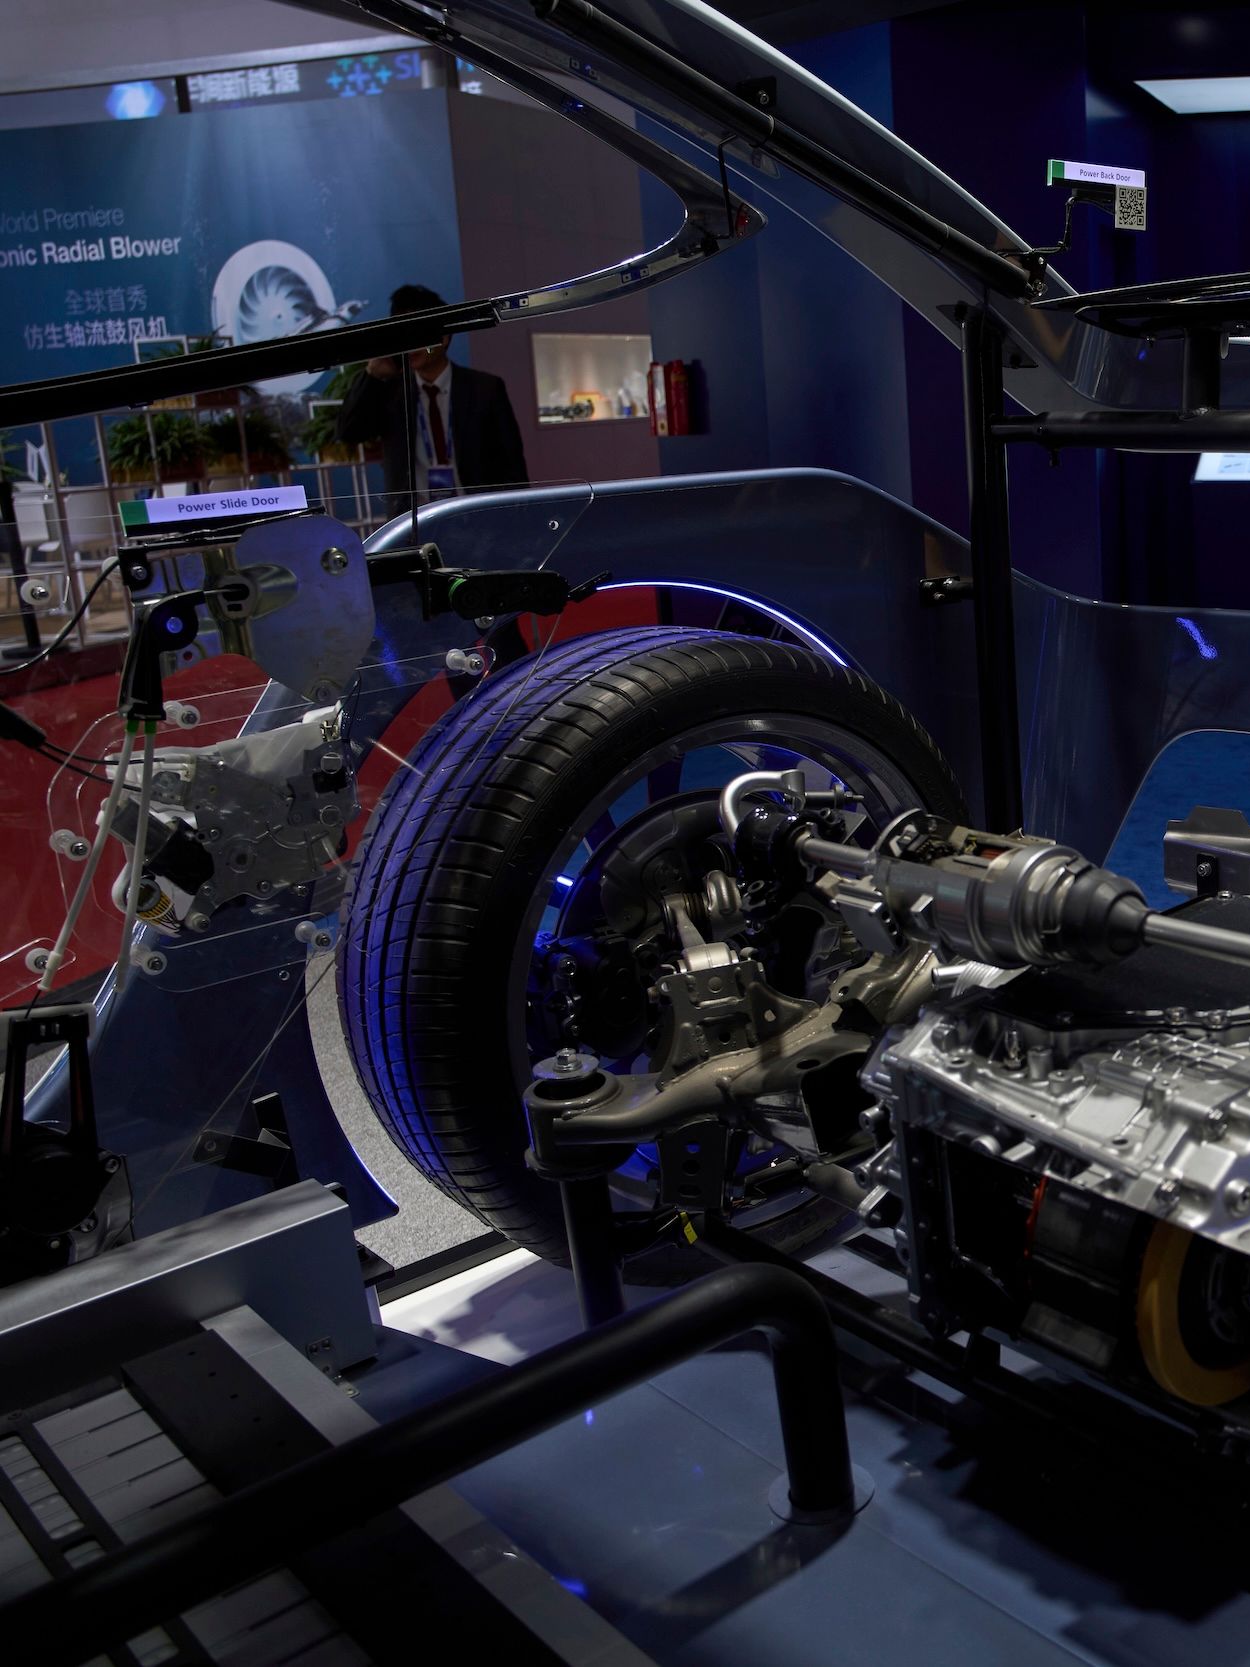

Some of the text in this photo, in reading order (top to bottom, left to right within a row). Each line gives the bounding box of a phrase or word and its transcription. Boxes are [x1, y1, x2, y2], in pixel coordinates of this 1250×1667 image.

[1080, 169, 1131, 182] Power Back Door
[43, 205, 125, 231] Premiere
[41, 237, 105, 264] Radial
[110, 236, 182, 260] Blower
[65, 284, 148, 315] 全球首秀
[24, 316, 170, 350] 仿生轴流鼓风机
[178, 495, 280, 514] Power Slide Door
